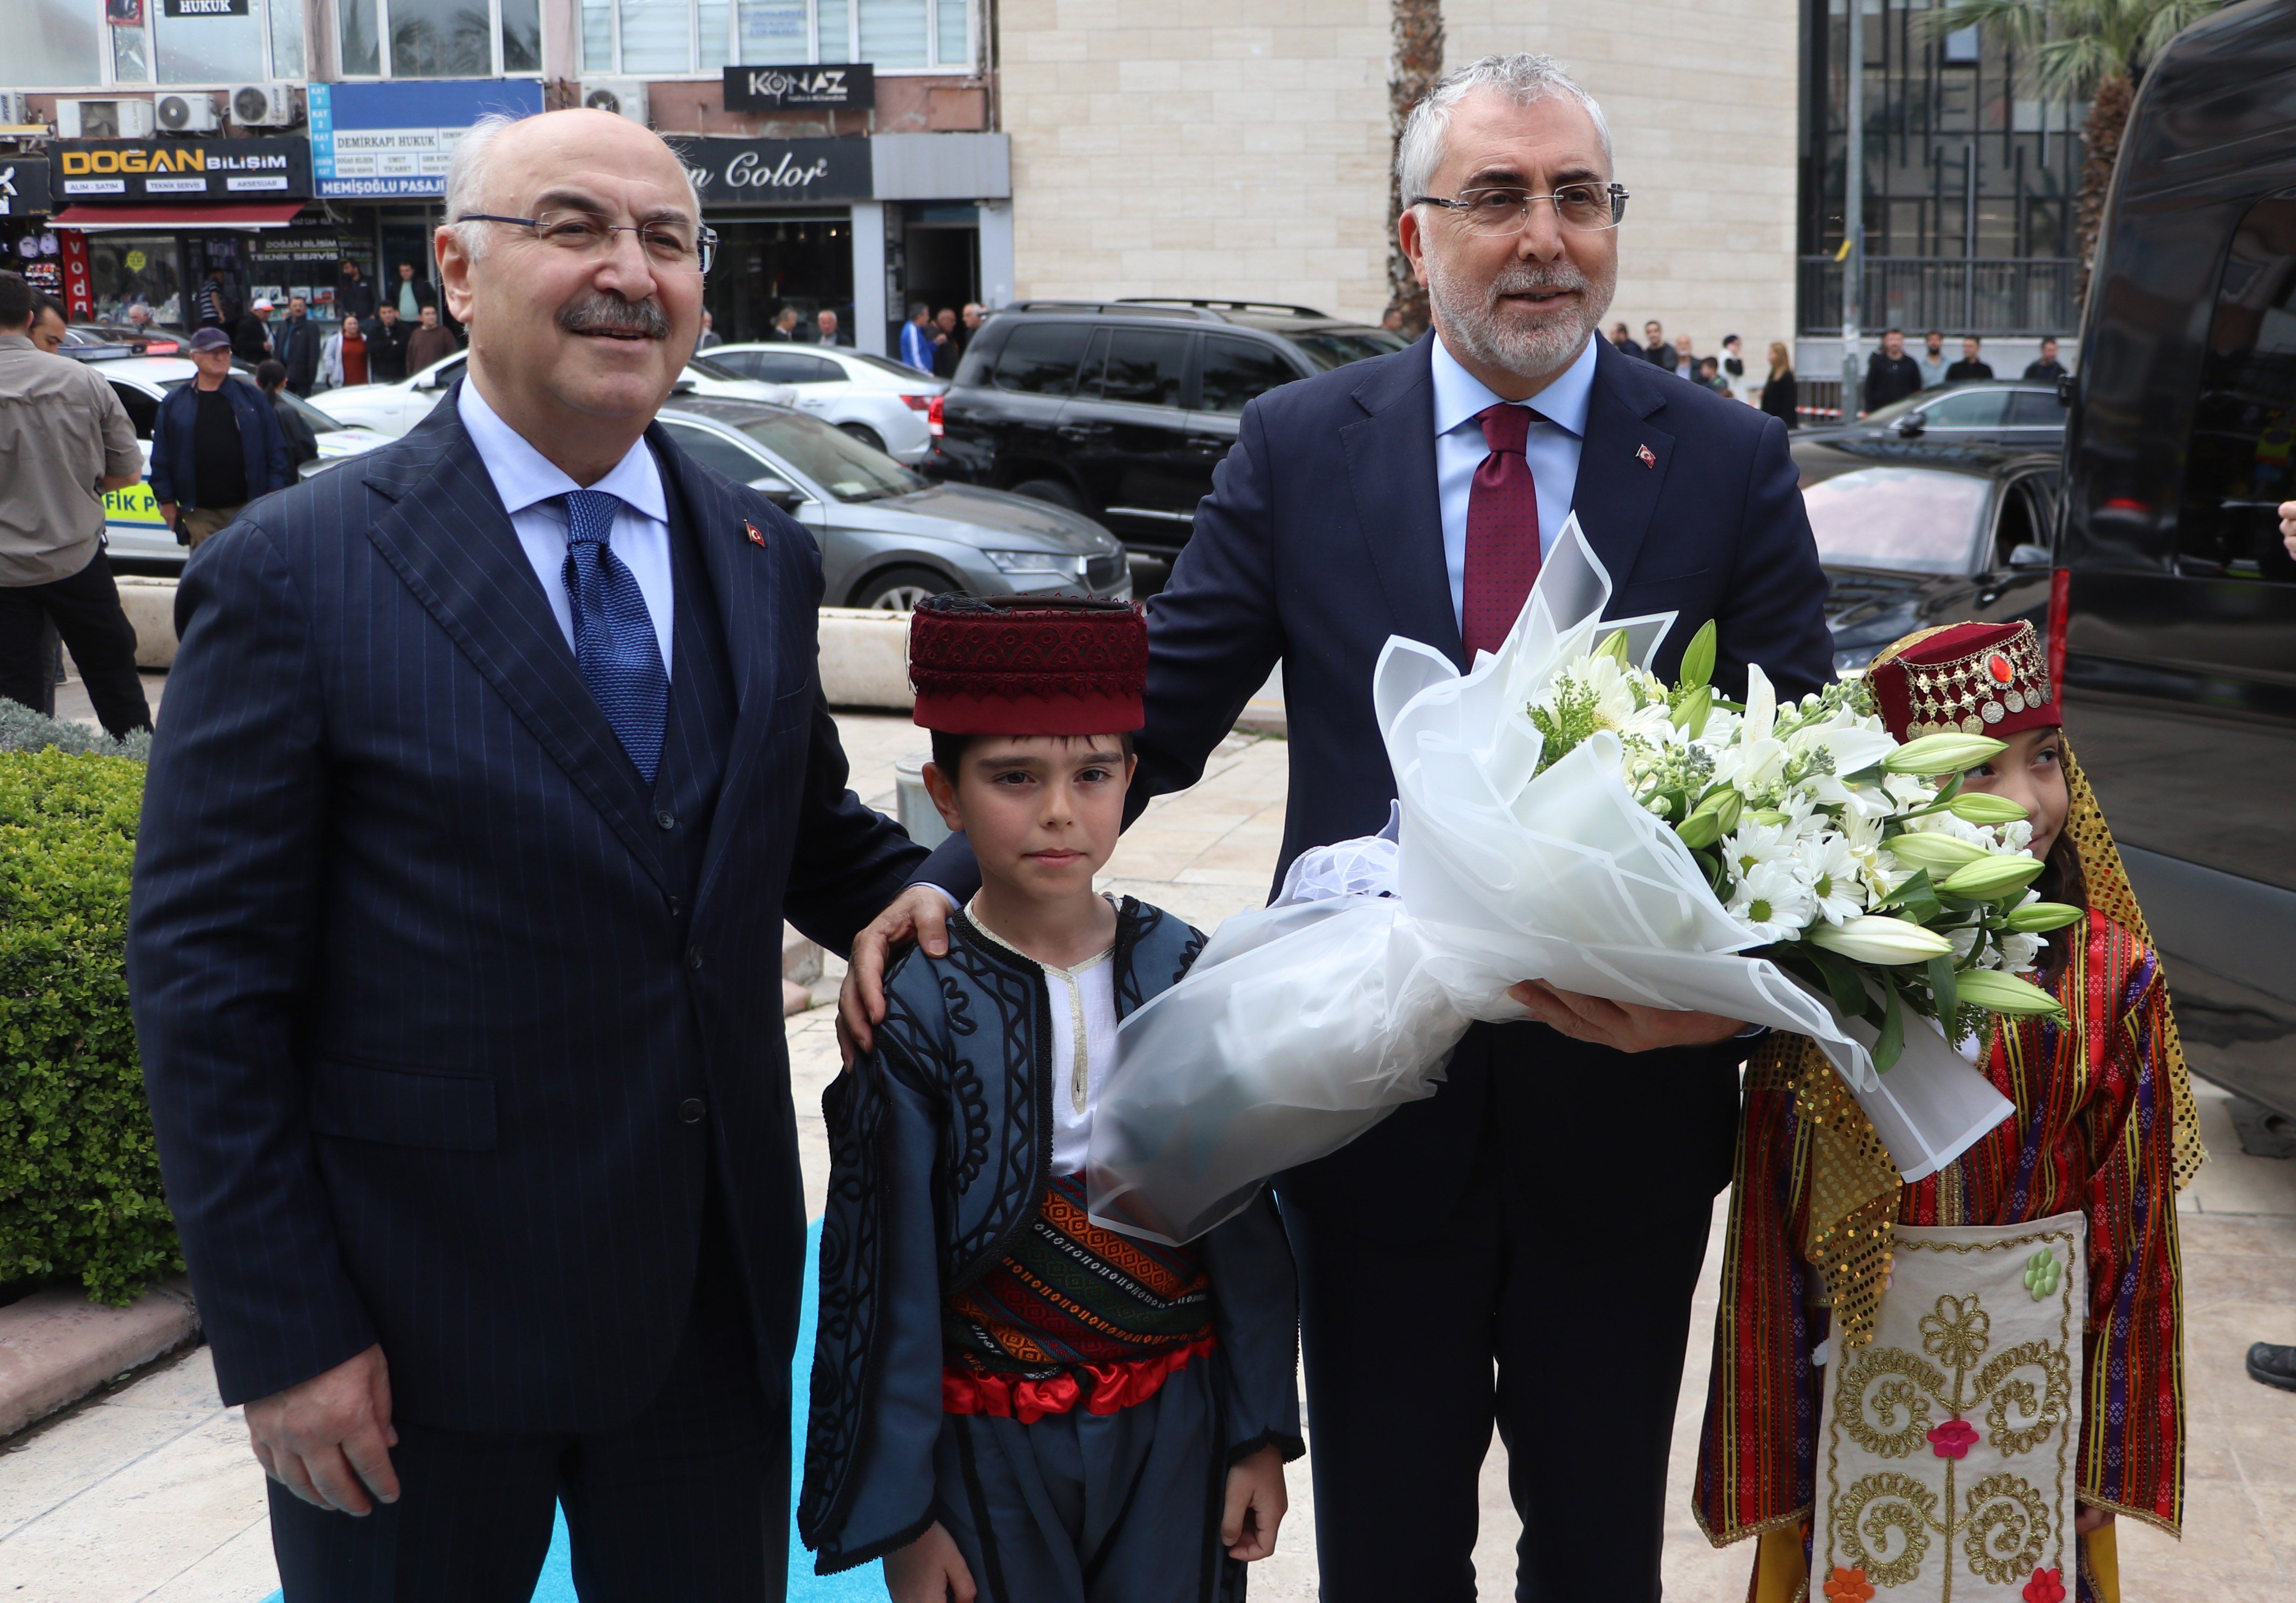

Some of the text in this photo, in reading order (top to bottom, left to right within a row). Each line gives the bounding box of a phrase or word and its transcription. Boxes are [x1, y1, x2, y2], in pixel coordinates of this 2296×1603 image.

[180, 0, 232, 13] HUKUK
[749, 70, 848, 105] KONAZ
[338, 135, 435, 148] DEMİRKAPI HUKUK
[62, 149, 205, 175] DOĞAN
[690, 168, 715, 187] n
[322, 178, 397, 194] MEMİŞOĞLU
[266, 240, 301, 248] DOĞAN
[251, 253, 291, 261] TEKNİK
[294, 252, 338, 260] SERVİS
[106, 490, 137, 511] FİK
